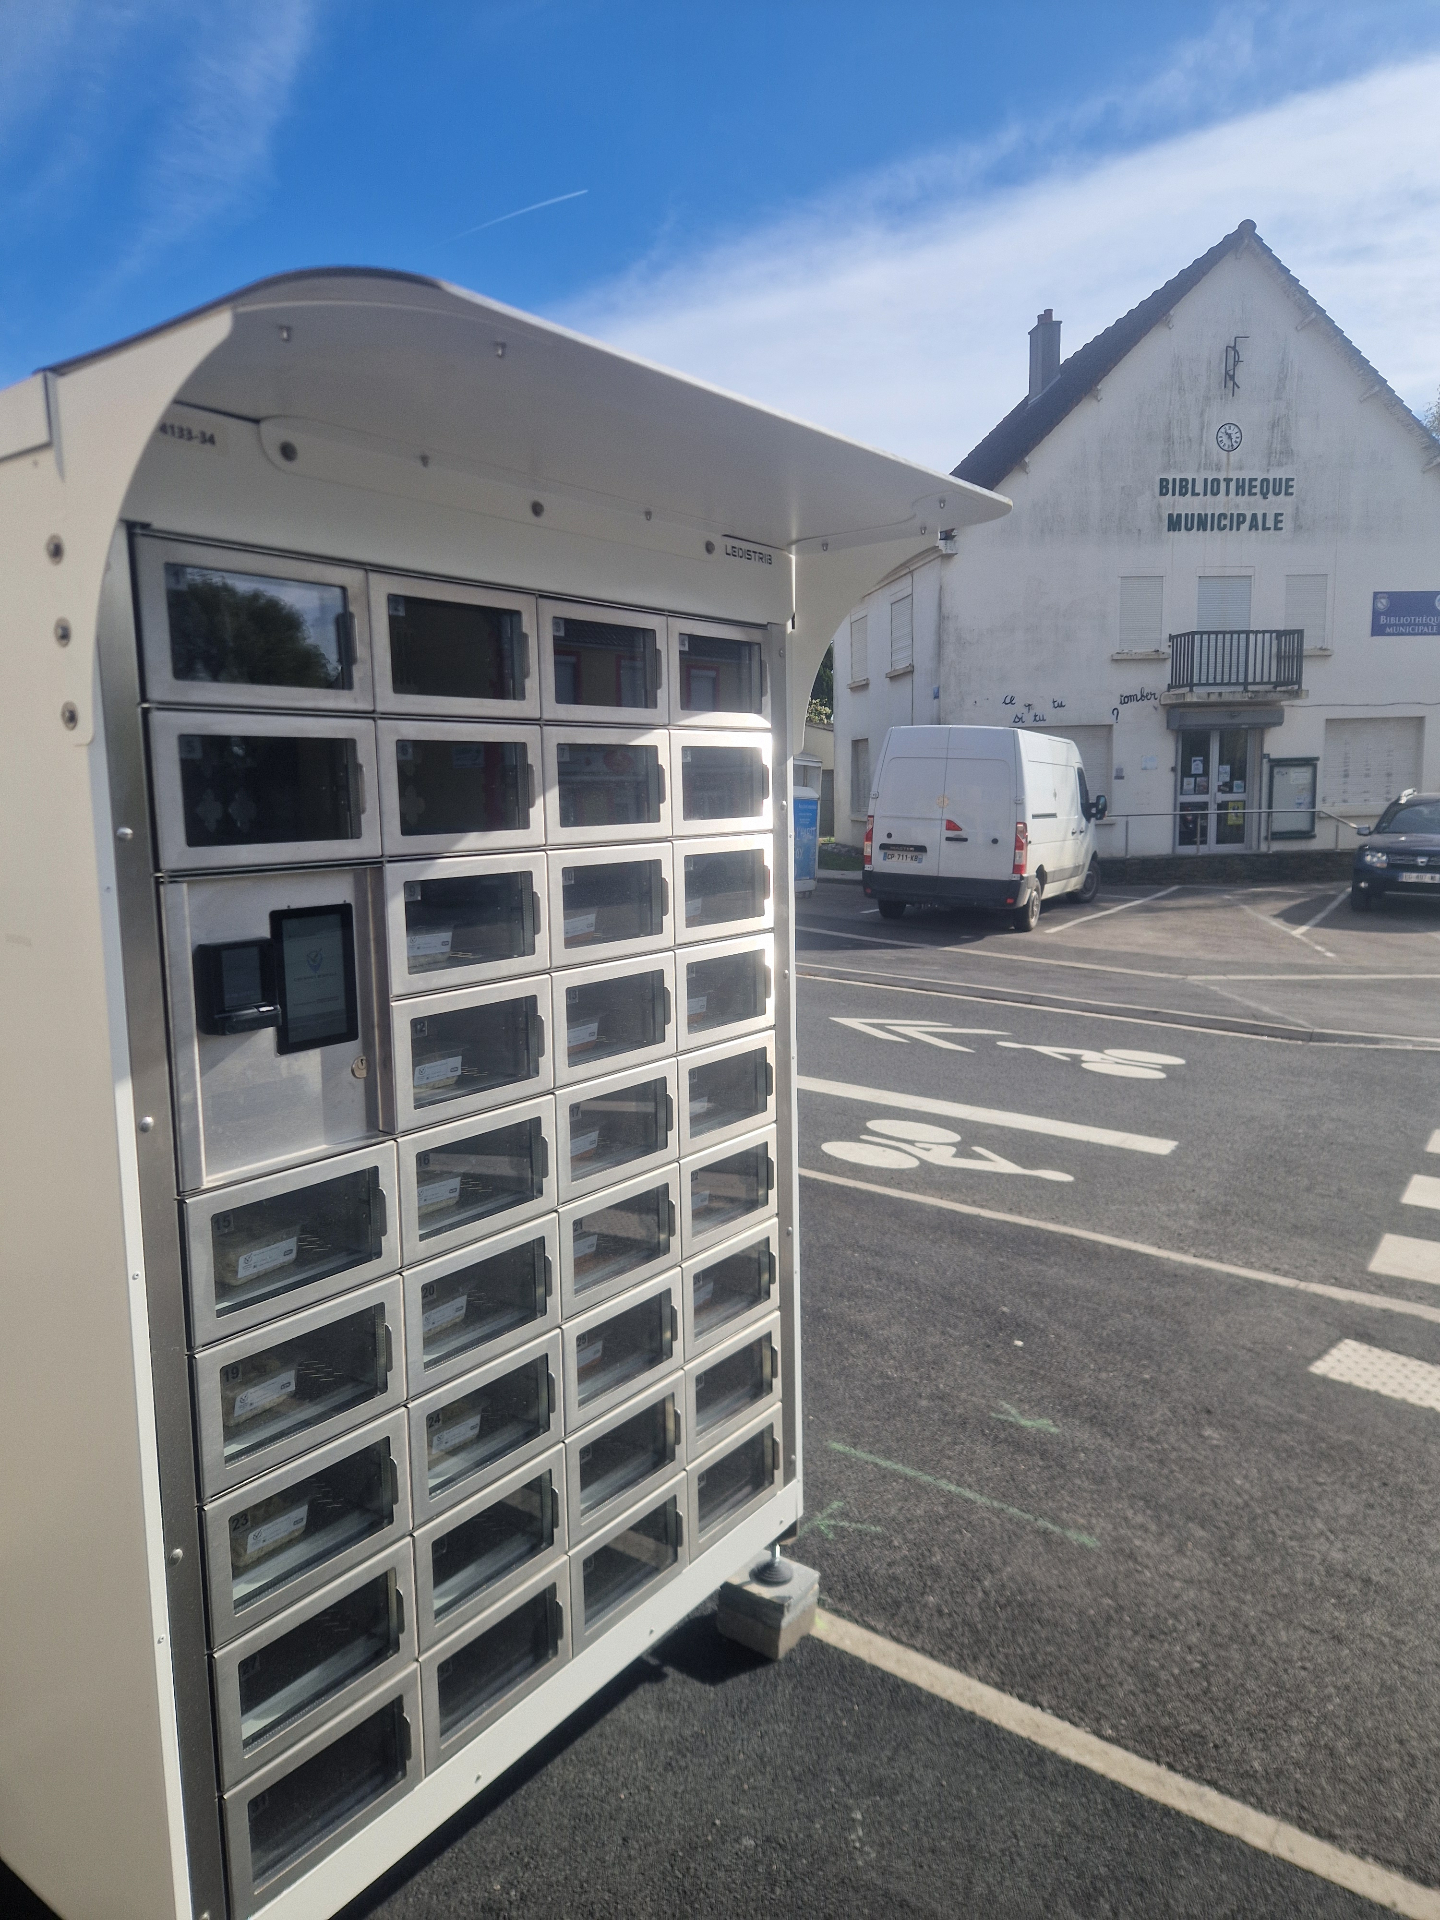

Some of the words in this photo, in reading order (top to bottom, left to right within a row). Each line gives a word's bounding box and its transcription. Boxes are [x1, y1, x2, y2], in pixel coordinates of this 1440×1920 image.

[1158, 477, 1296, 499] BIBLIOTHEQUE
[1167, 512, 1285, 532] MUNICIPALE
[725, 544, 773, 565] LEDISTRIB
[1380, 615, 1440, 625] BIBLIOTHÈQU
[1385, 625, 1438, 634] MUNICIPALE
[1052, 698, 1066, 709] tu
[1012, 712, 1026, 724] si
[1032, 712, 1047, 723] tu
[1111, 707, 1120, 724] ?
[568, 989, 577, 1002] 13
[412, 1021, 426, 1035] 12
[571, 1105, 581, 1118] 17
[417, 1153, 430, 1168] 16
[213, 1214, 231, 1231] 15
[573, 1220, 583, 1233] 21
[421, 1284, 435, 1299] 20
[222, 1365, 240, 1382] 19
[428, 1412, 441, 1429] 24
[231, 1513, 249, 1532] 23
